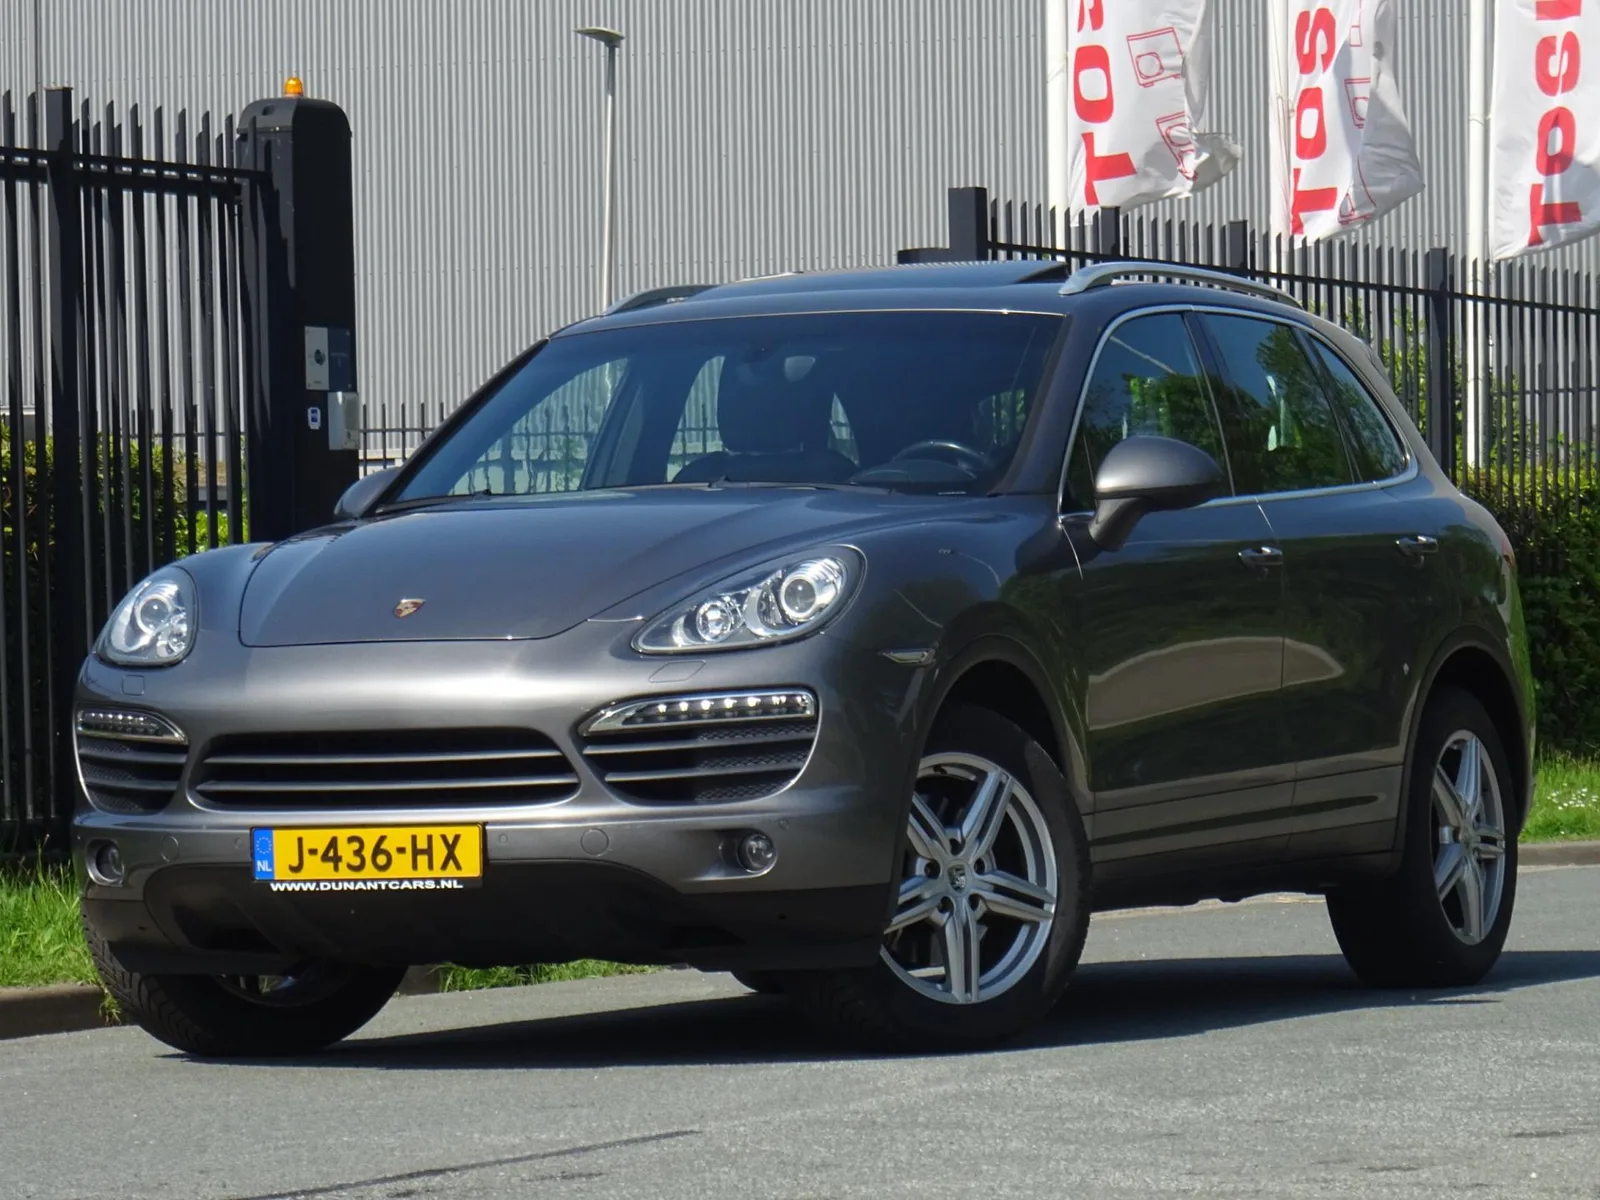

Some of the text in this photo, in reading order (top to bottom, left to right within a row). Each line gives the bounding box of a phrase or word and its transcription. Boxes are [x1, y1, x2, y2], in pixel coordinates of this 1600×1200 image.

[1290, 7, 1337, 234] TOS
[288, 834, 463, 873] J-436-HX
[257, 861, 272, 872] NL
[270, 880, 463, 891] WWW.DUNANTCARS.NL
